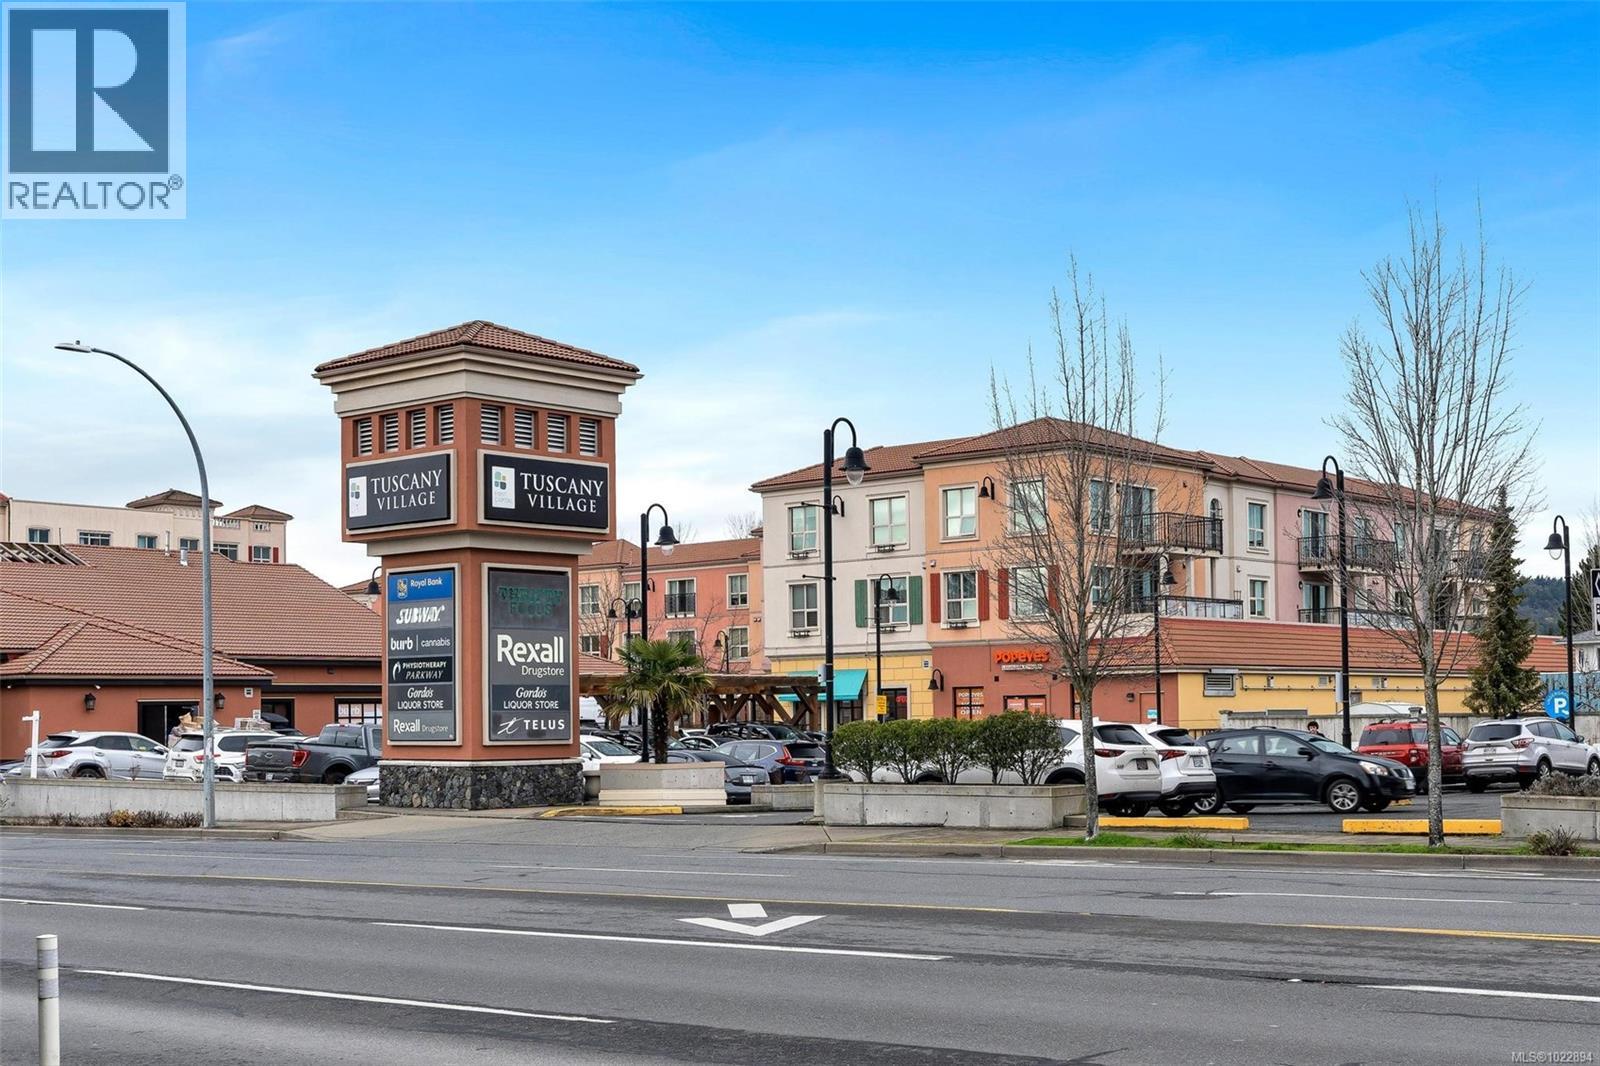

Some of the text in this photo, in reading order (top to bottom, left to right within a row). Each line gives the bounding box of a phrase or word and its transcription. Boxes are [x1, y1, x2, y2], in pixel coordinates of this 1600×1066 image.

[371, 469, 443, 495] TUSCANY
[519, 472, 604, 497] TUSCANY
[376, 490, 436, 511] VILLAGE
[527, 494, 597, 513] VILLAGE
[410, 576, 443, 589] Royal Bank
[396, 605, 445, 624] SUBWAY
[390, 637, 451, 651] burb cannabis
[497, 633, 564, 666] Rexall
[402, 661, 447, 670] PHYSIOTHERAPY
[521, 665, 565, 679] Drugstore
[406, 670, 444, 681] PARKWAY
[407, 686, 434, 700] Gordo's
[515, 686, 547, 699] Gordo's
[397, 700, 444, 710] LIQUOR STORE
[503, 700, 559, 711] LIQUOR STORE
[393, 718, 449, 734] Rexall Drugstore
[523, 719, 565, 730] TELUS
